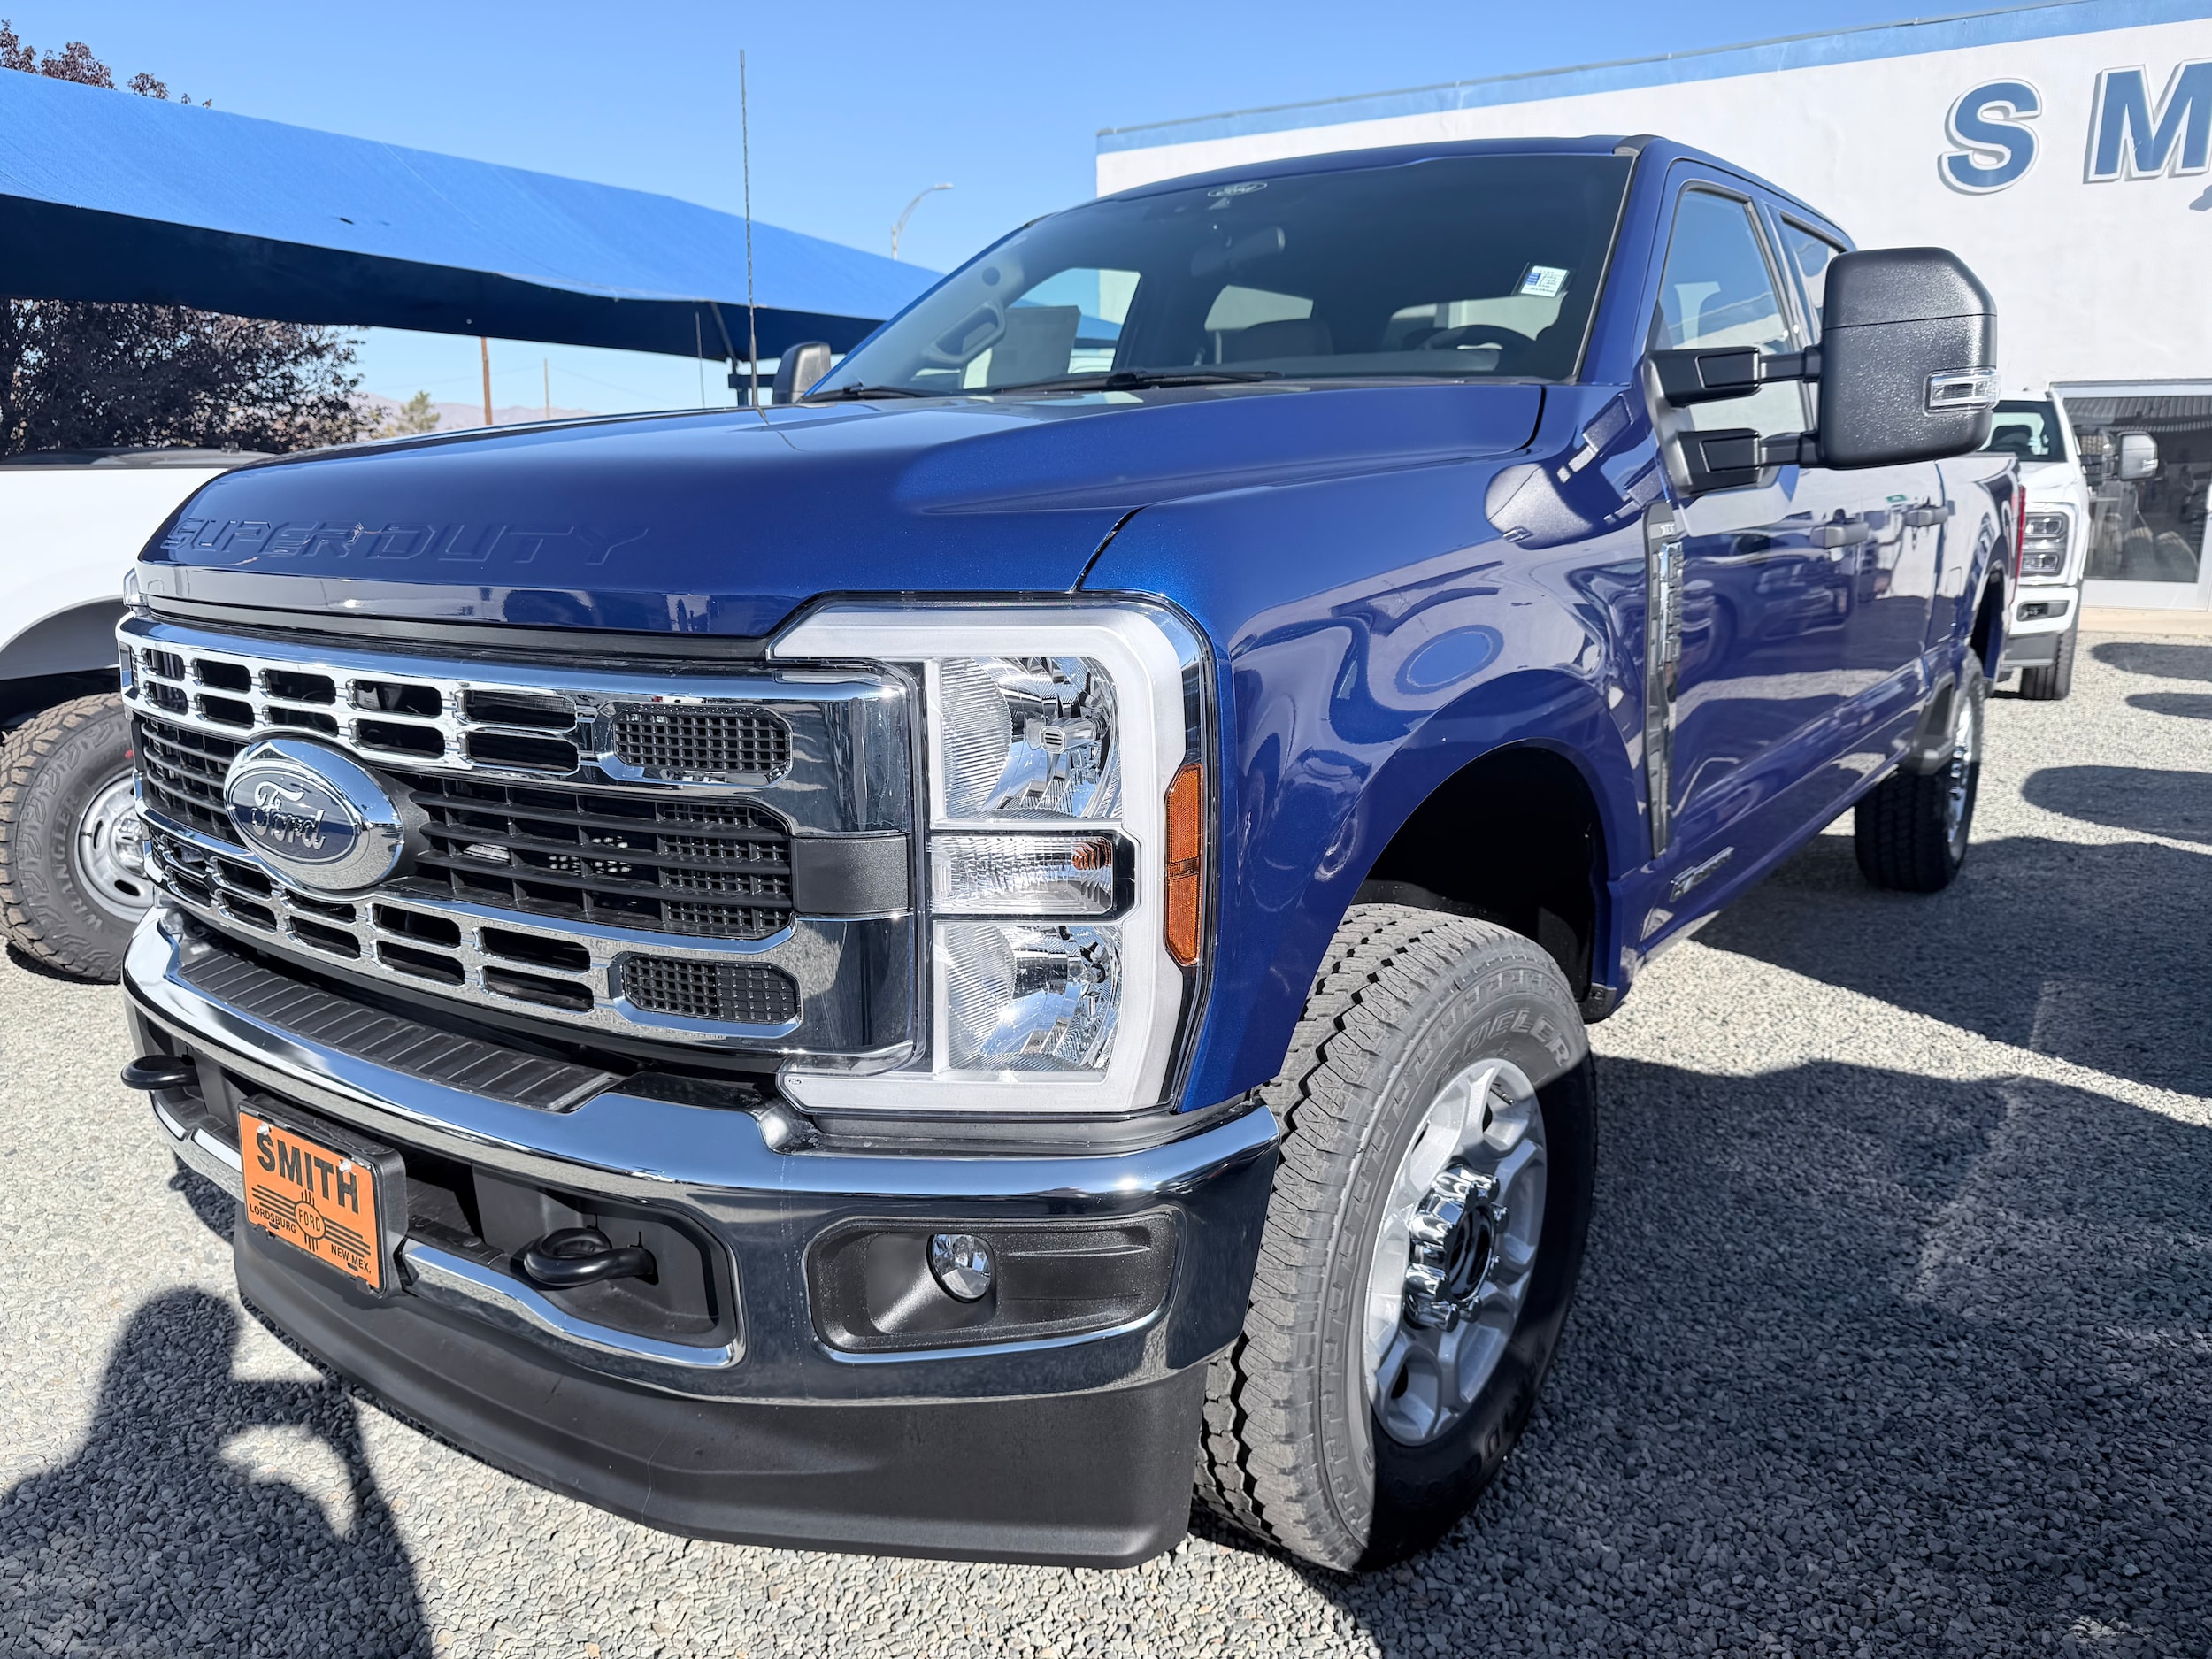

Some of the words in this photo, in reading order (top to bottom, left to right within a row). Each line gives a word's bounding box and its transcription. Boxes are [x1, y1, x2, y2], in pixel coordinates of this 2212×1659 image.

[160, 517, 364, 559] SUPER
[365, 522, 649, 565] DUTY
[250, 781, 326, 850] Ford
[50, 792, 104, 929] WRANGLER
[256, 1132, 359, 1215] SMITH
[249, 1202, 297, 1235] LORDSBURG
[297, 1208, 322, 1233] FORD
[330, 1243, 349, 1262] NEW
[351, 1253, 373, 1275] MEX.
